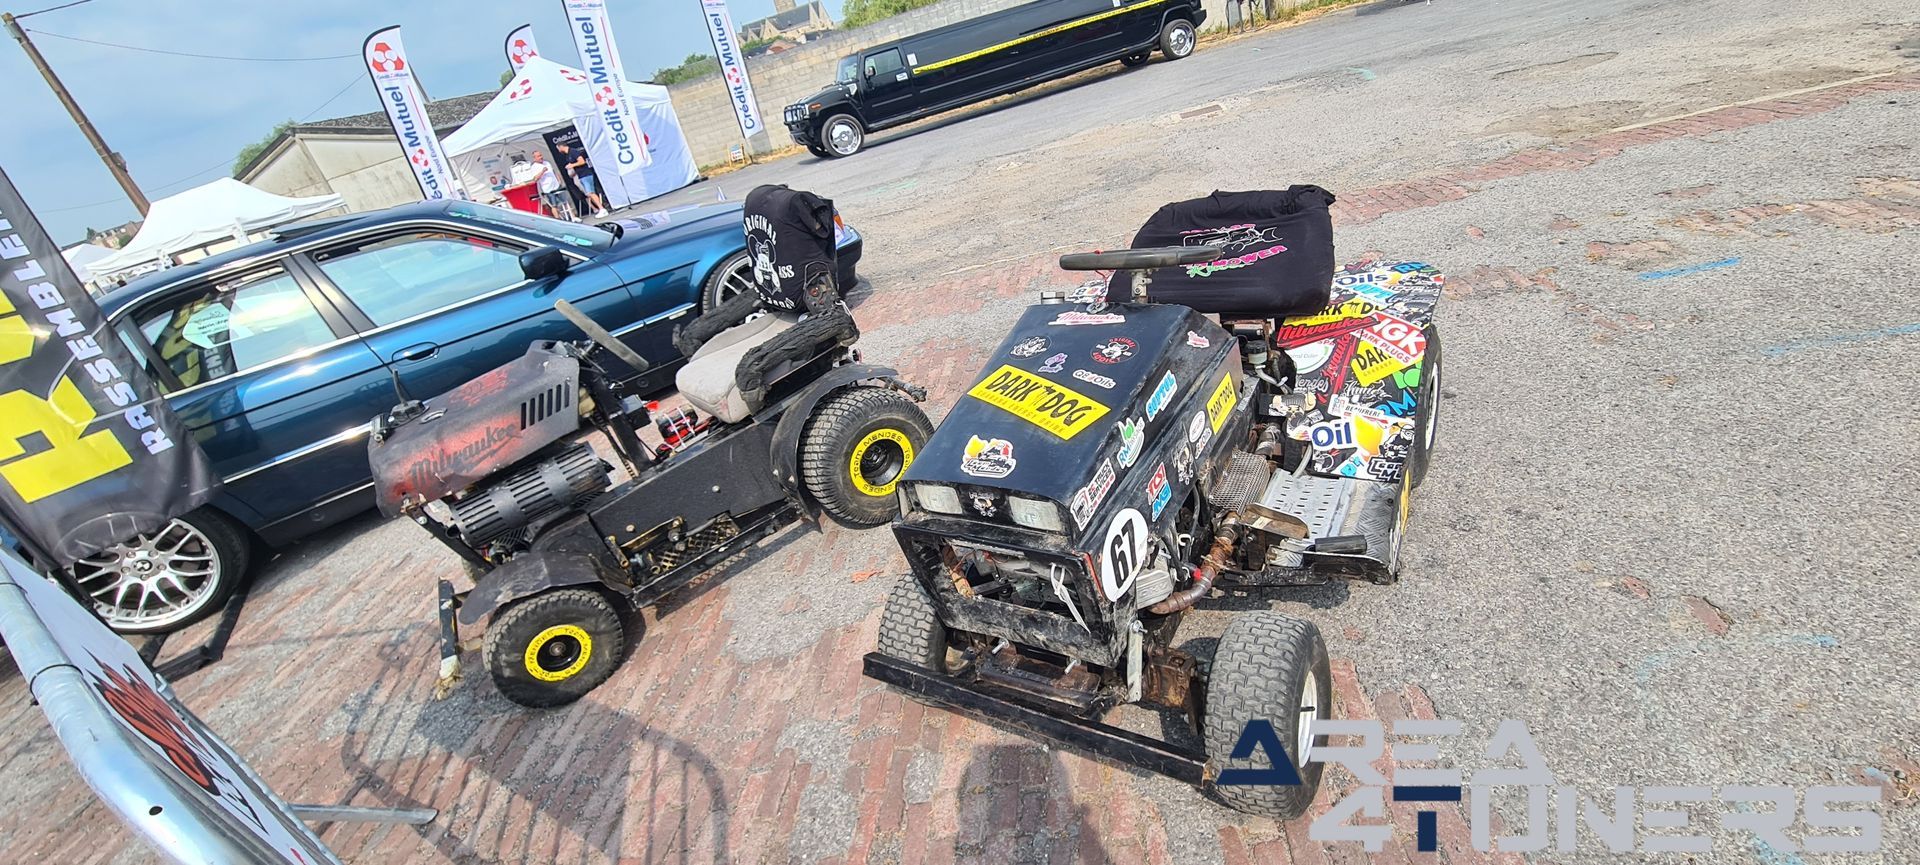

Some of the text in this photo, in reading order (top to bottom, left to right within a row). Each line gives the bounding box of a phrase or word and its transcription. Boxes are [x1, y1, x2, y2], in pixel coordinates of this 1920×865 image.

[709, 13, 735, 67] Mutuel
[575, 16, 634, 165] Crédit Mutuel
[734, 85, 755, 130] Crédit
[384, 85, 443, 200] édit Mutuel
[1336, 273, 1388, 286] Oils
[1356, 345, 1394, 371] DAR
[1378, 342, 1411, 364] PLUGS
[985, 371, 1092, 427] DARK DOG
[1110, 518, 1138, 590] 67
